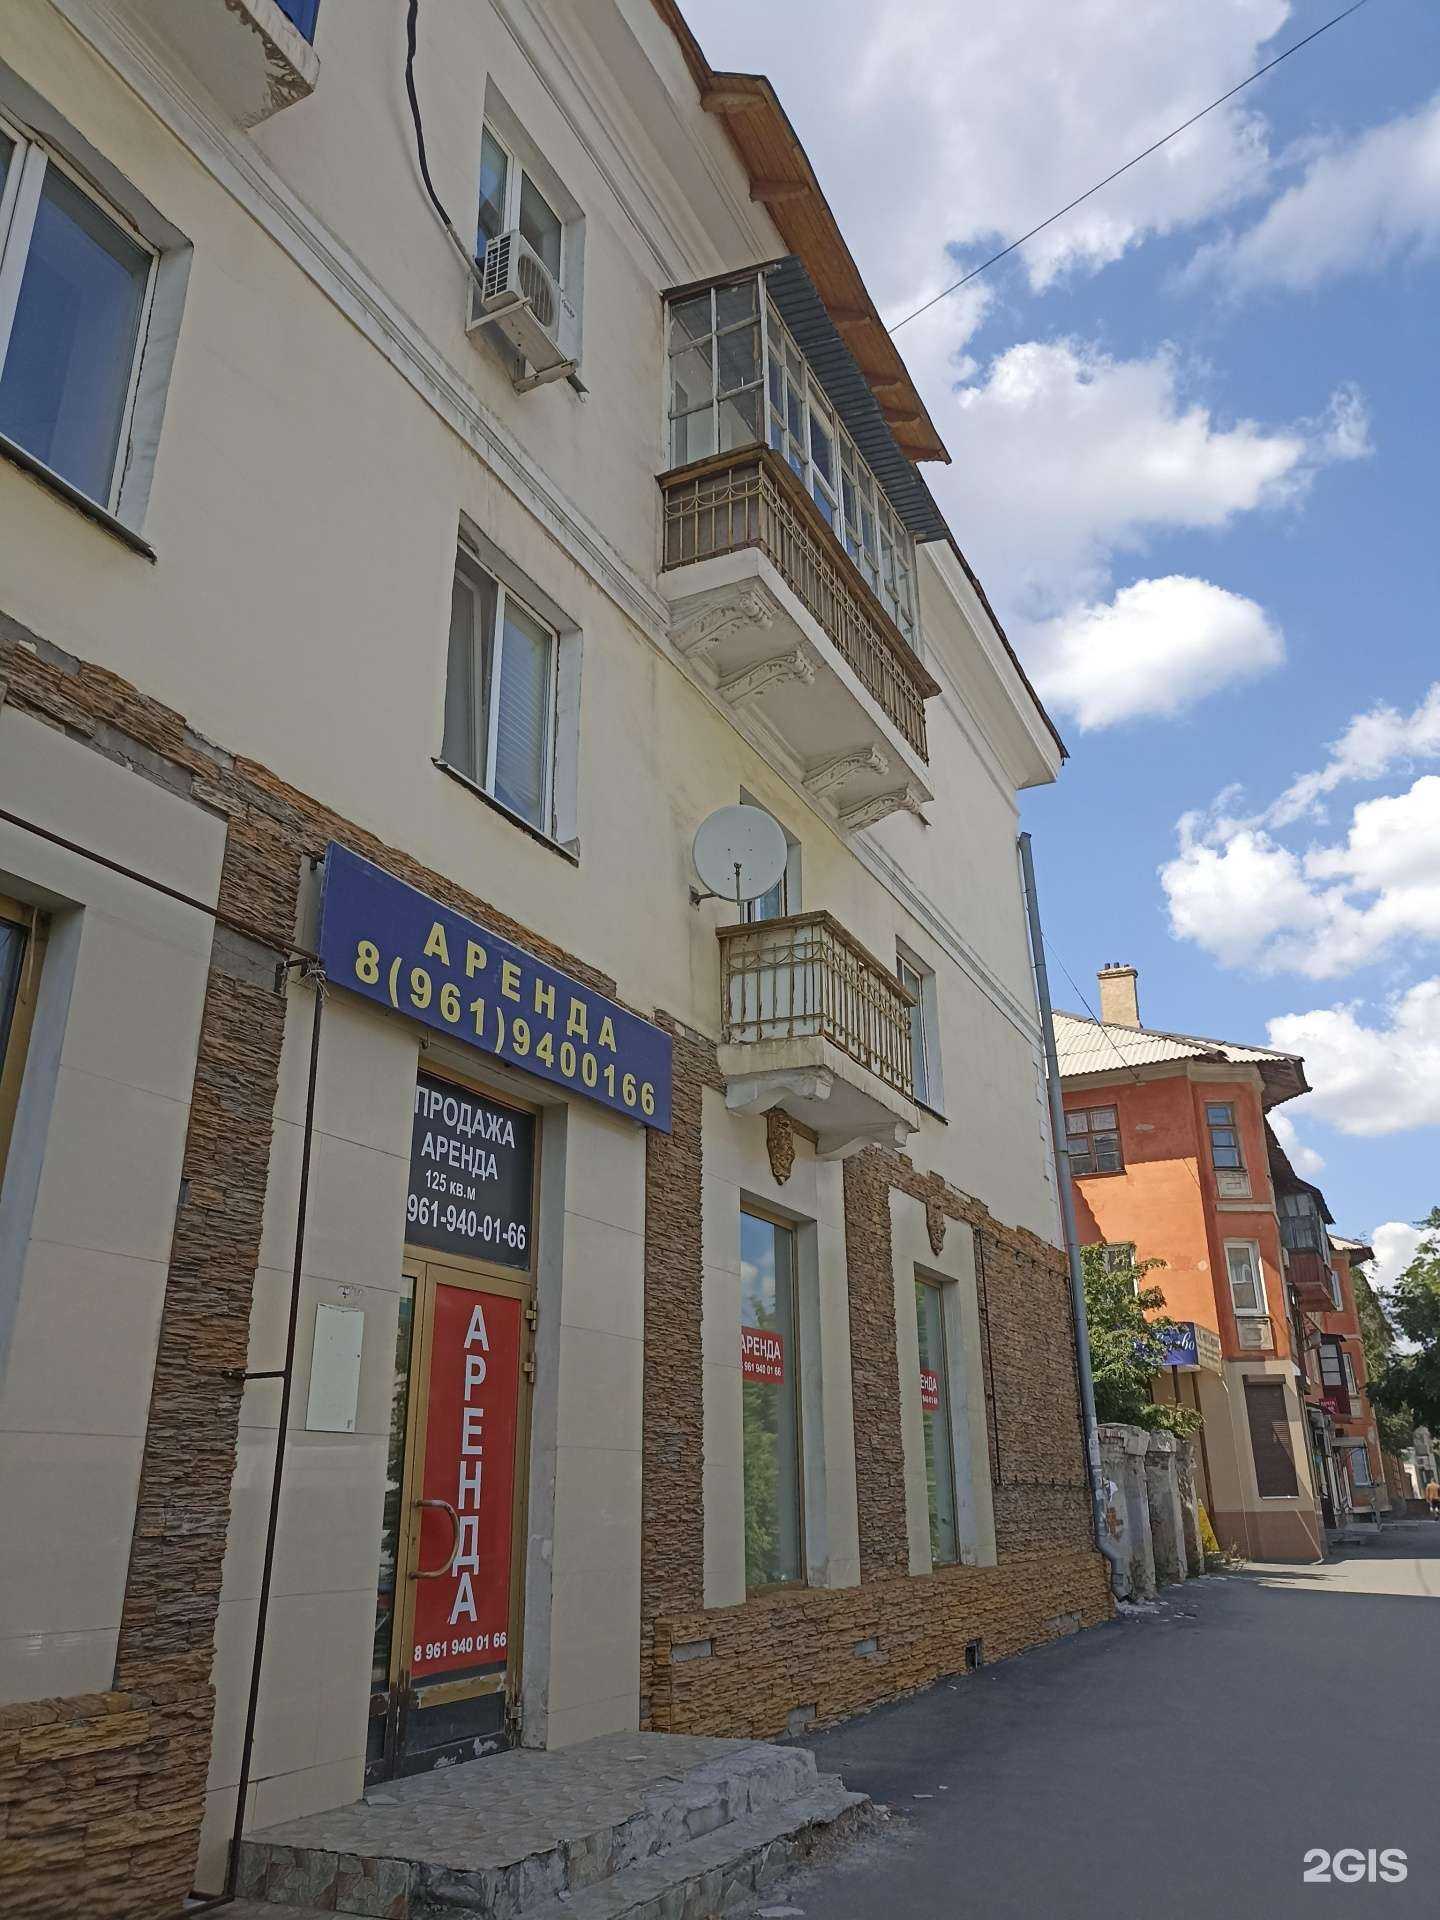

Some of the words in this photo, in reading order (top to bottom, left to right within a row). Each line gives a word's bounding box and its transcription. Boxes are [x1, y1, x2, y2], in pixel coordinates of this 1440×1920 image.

[423, 921, 617, 1053] АРЕНДА
[355, 939, 655, 1116] 8(961)9400166
[414, 1085, 515, 1149] ПРОДАЖА
[420, 1131, 498, 1181] АРЕНДА
[425, 1169, 447, 1192] 125
[407, 1193, 527, 1250] 961-940-01-66
[447, 1304, 490, 1625] АРЕНДА
[414, 1645, 422, 1662] 8
[425, 1641, 447, 1660] 961
[451, 1636, 473, 1655] 940
[476, 1634, 489, 1651] 01
[493, 1631, 507, 1648] 66
